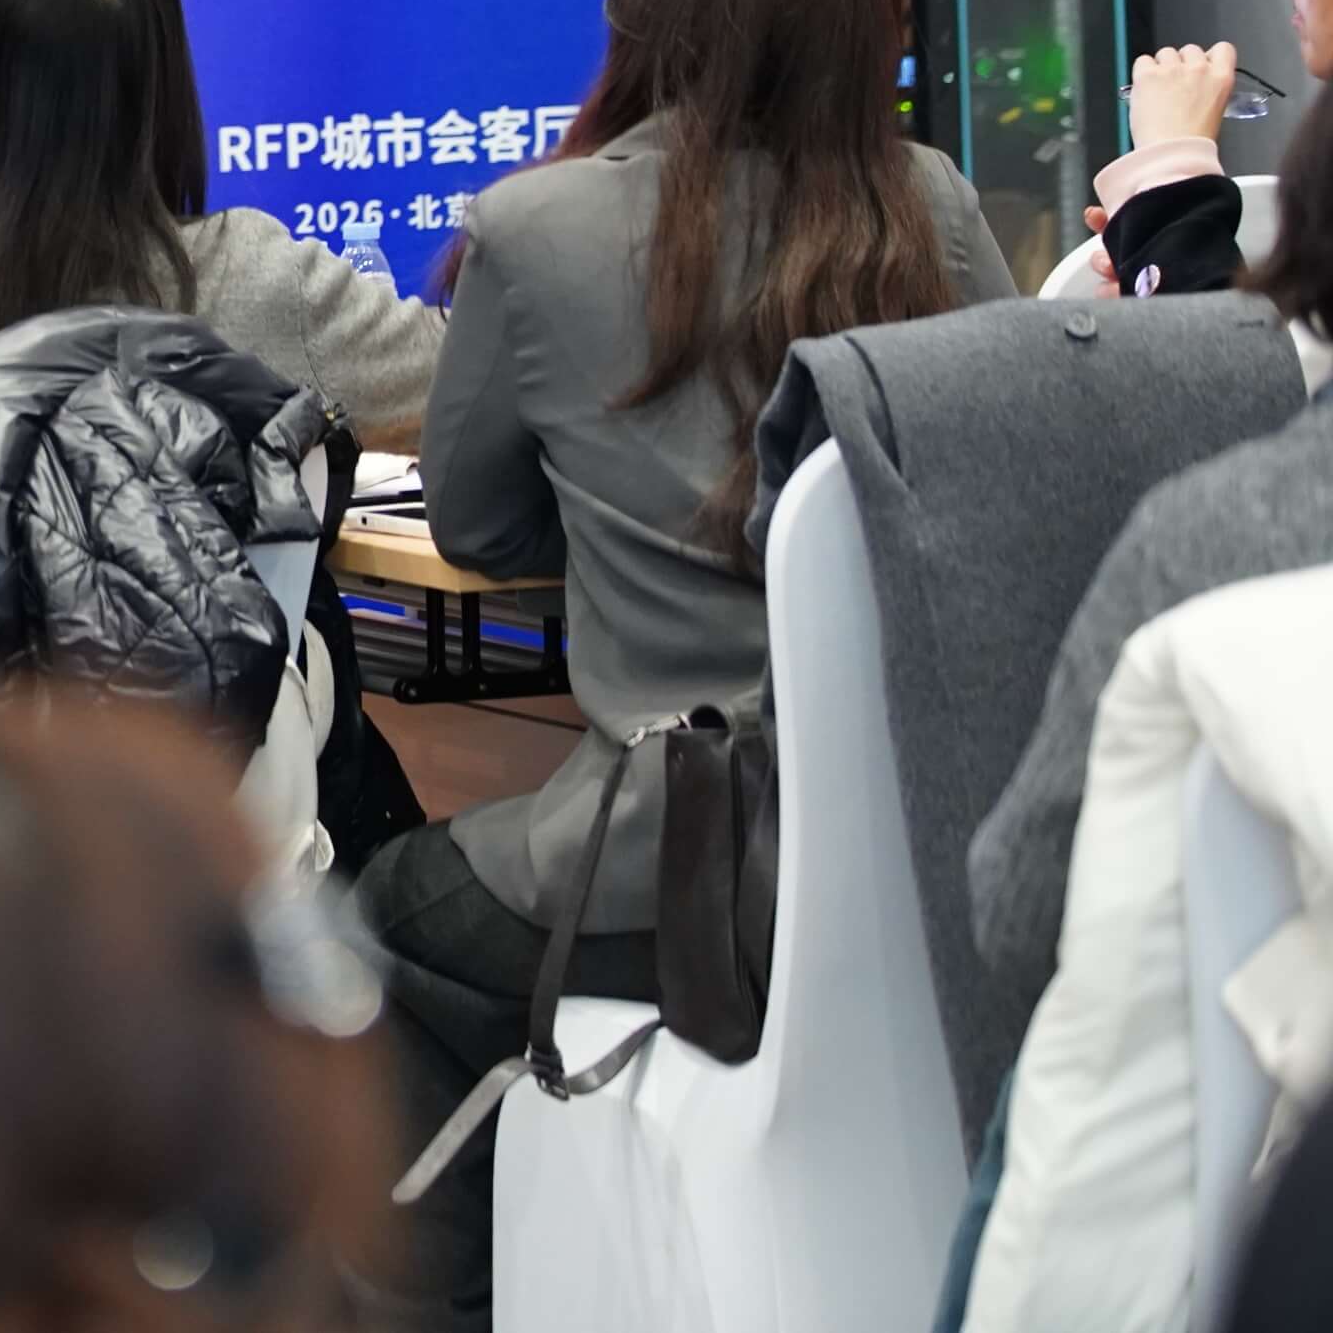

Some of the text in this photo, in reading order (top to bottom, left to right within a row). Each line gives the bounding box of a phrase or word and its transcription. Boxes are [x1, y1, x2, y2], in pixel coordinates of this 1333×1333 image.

[218, 104, 581, 173] RFP城市会客厅
